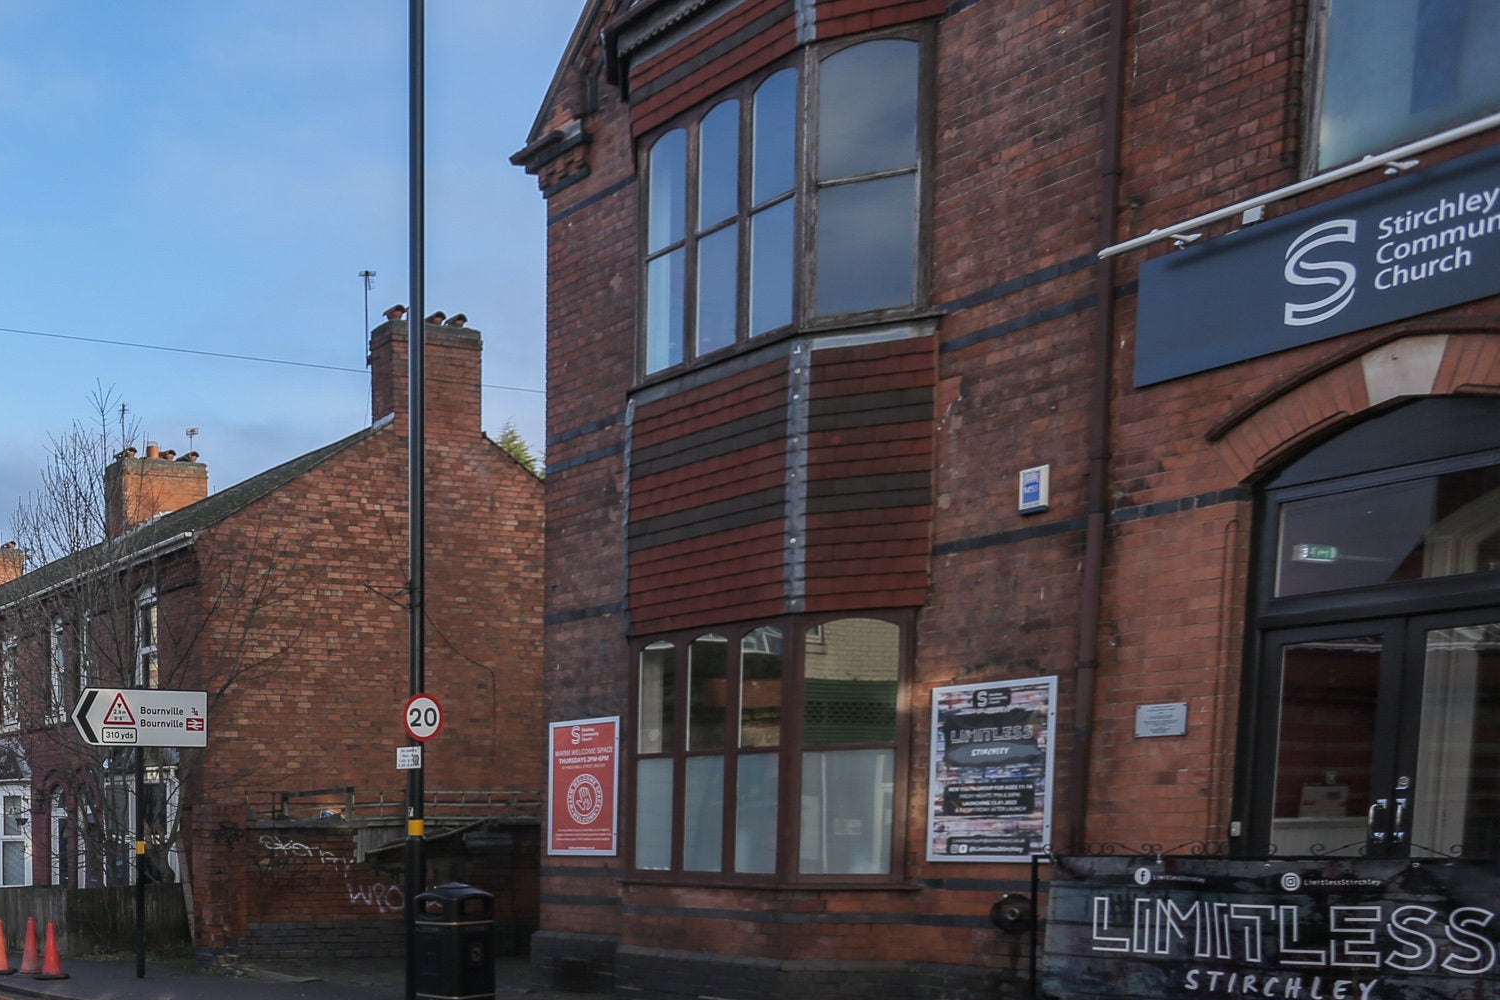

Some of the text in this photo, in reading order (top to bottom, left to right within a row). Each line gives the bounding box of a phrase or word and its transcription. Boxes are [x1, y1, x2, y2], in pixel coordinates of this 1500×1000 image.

[1377, 187, 1500, 240] Stirchley
[1374, 246, 1472, 291] Church
[140, 706, 184, 716] Bournville
[409, 707, 437, 727] 20
[140, 719, 184, 729] Bournville
[106, 731, 134, 740] 310 yds
[950, 725, 1033, 744] LIMITLESS
[571, 747, 596, 755] WELCOME
[971, 746, 1011, 757] STIRCHLEY
[1304, 879, 1381, 887] LimitlessStirchley
[1092, 895, 1497, 975] LIMITLESS
